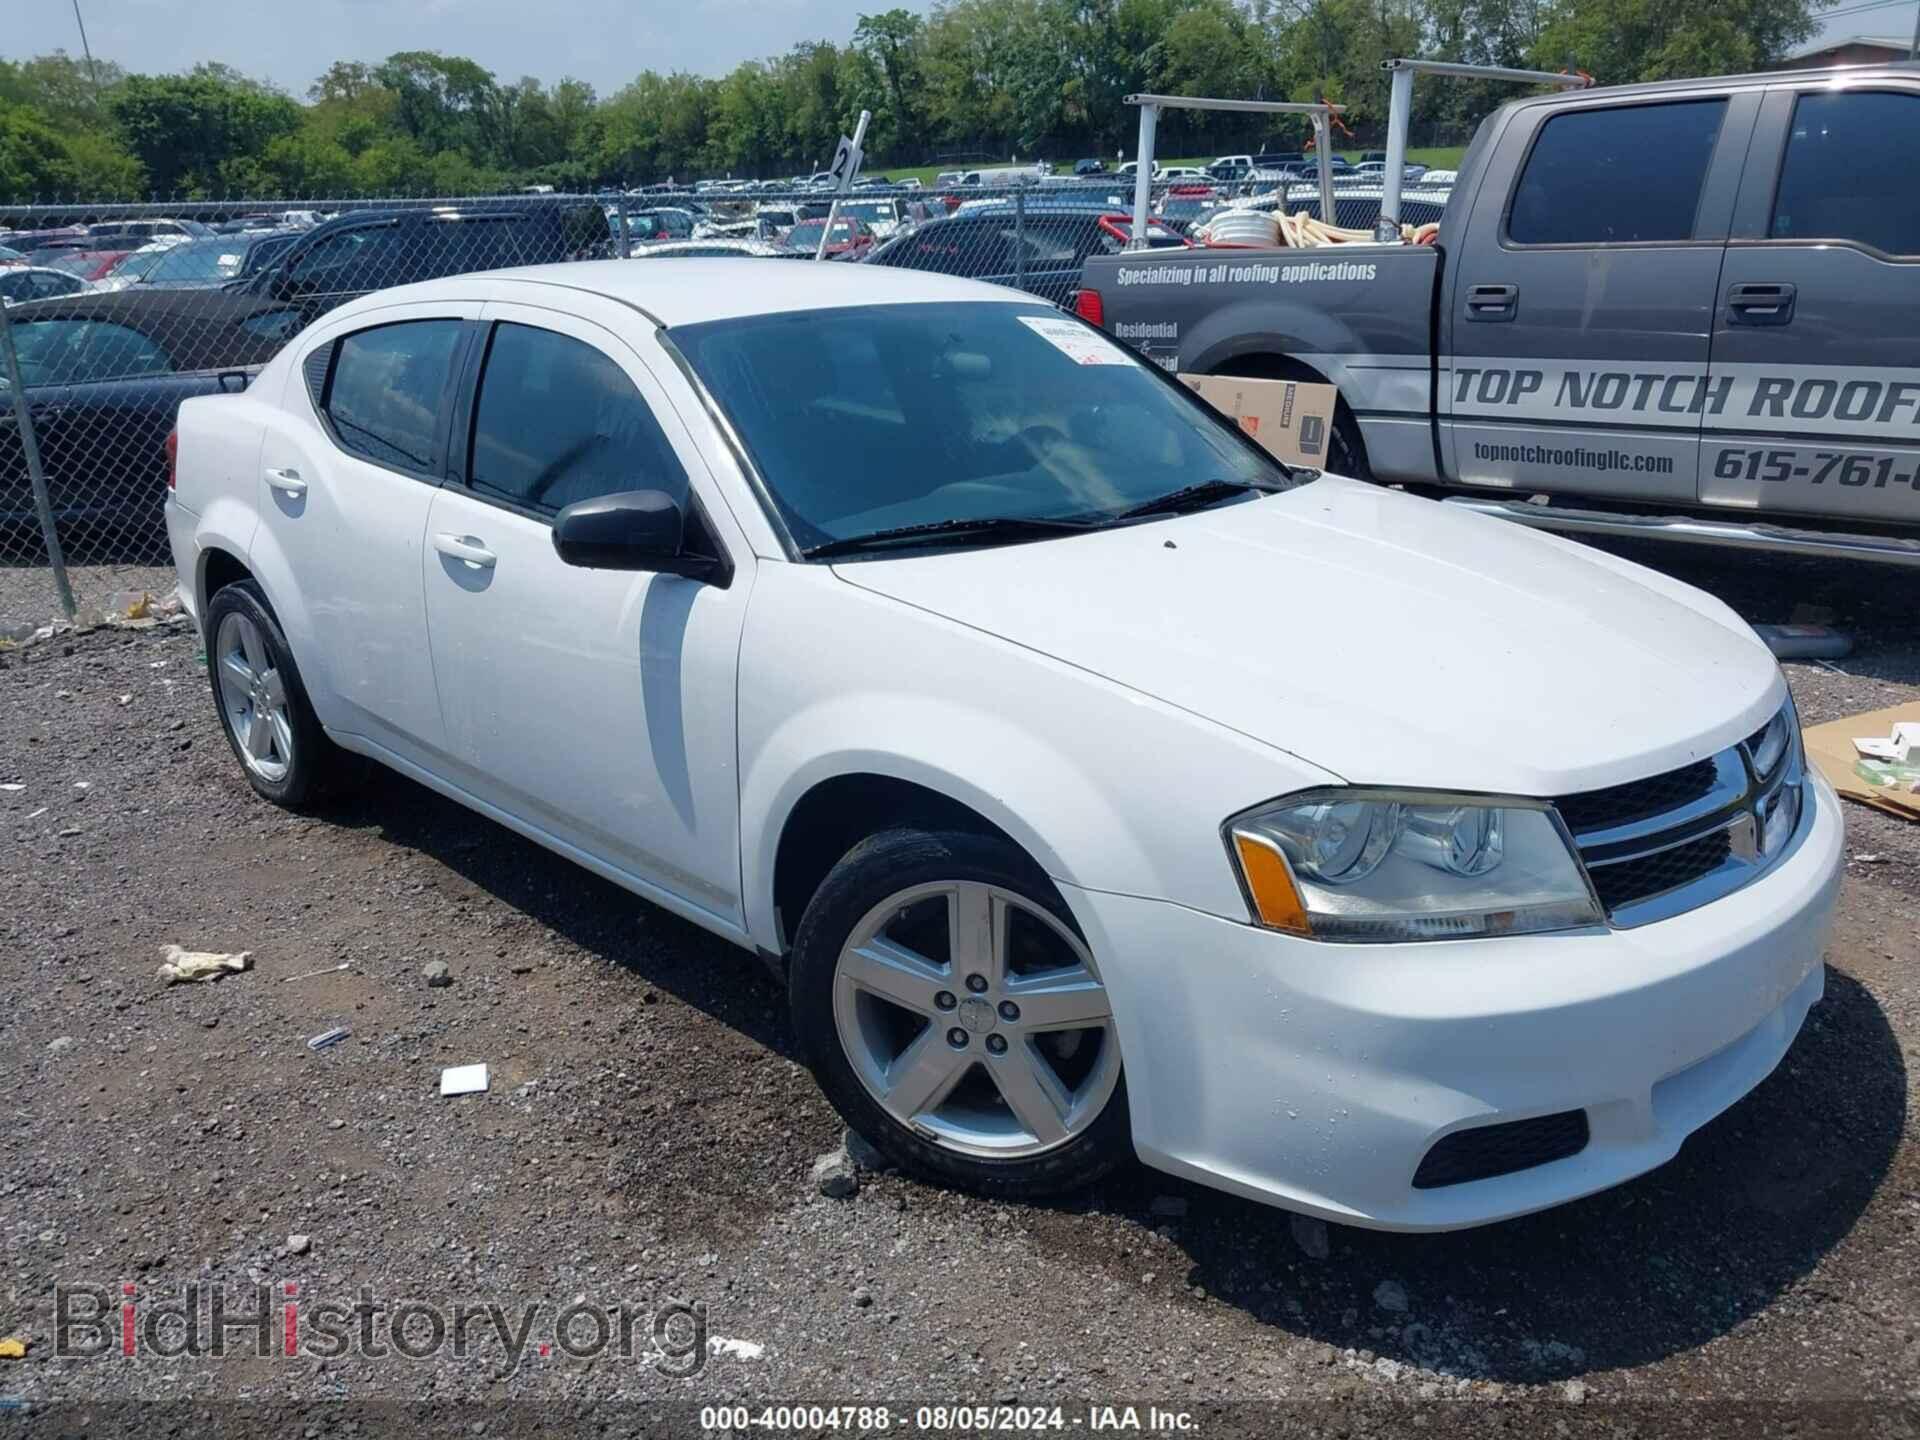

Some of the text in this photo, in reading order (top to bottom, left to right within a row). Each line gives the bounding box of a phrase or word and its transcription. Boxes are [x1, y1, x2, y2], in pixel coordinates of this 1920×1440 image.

[1117, 261, 1376, 286] Specializing in all roofing applications
[1115, 322, 1178, 338] Residential
[1454, 368, 1543, 405] TOP
[1553, 371, 1735, 415] NOTCH
[1474, 441, 1674, 474] topnotchroofingllc.com
